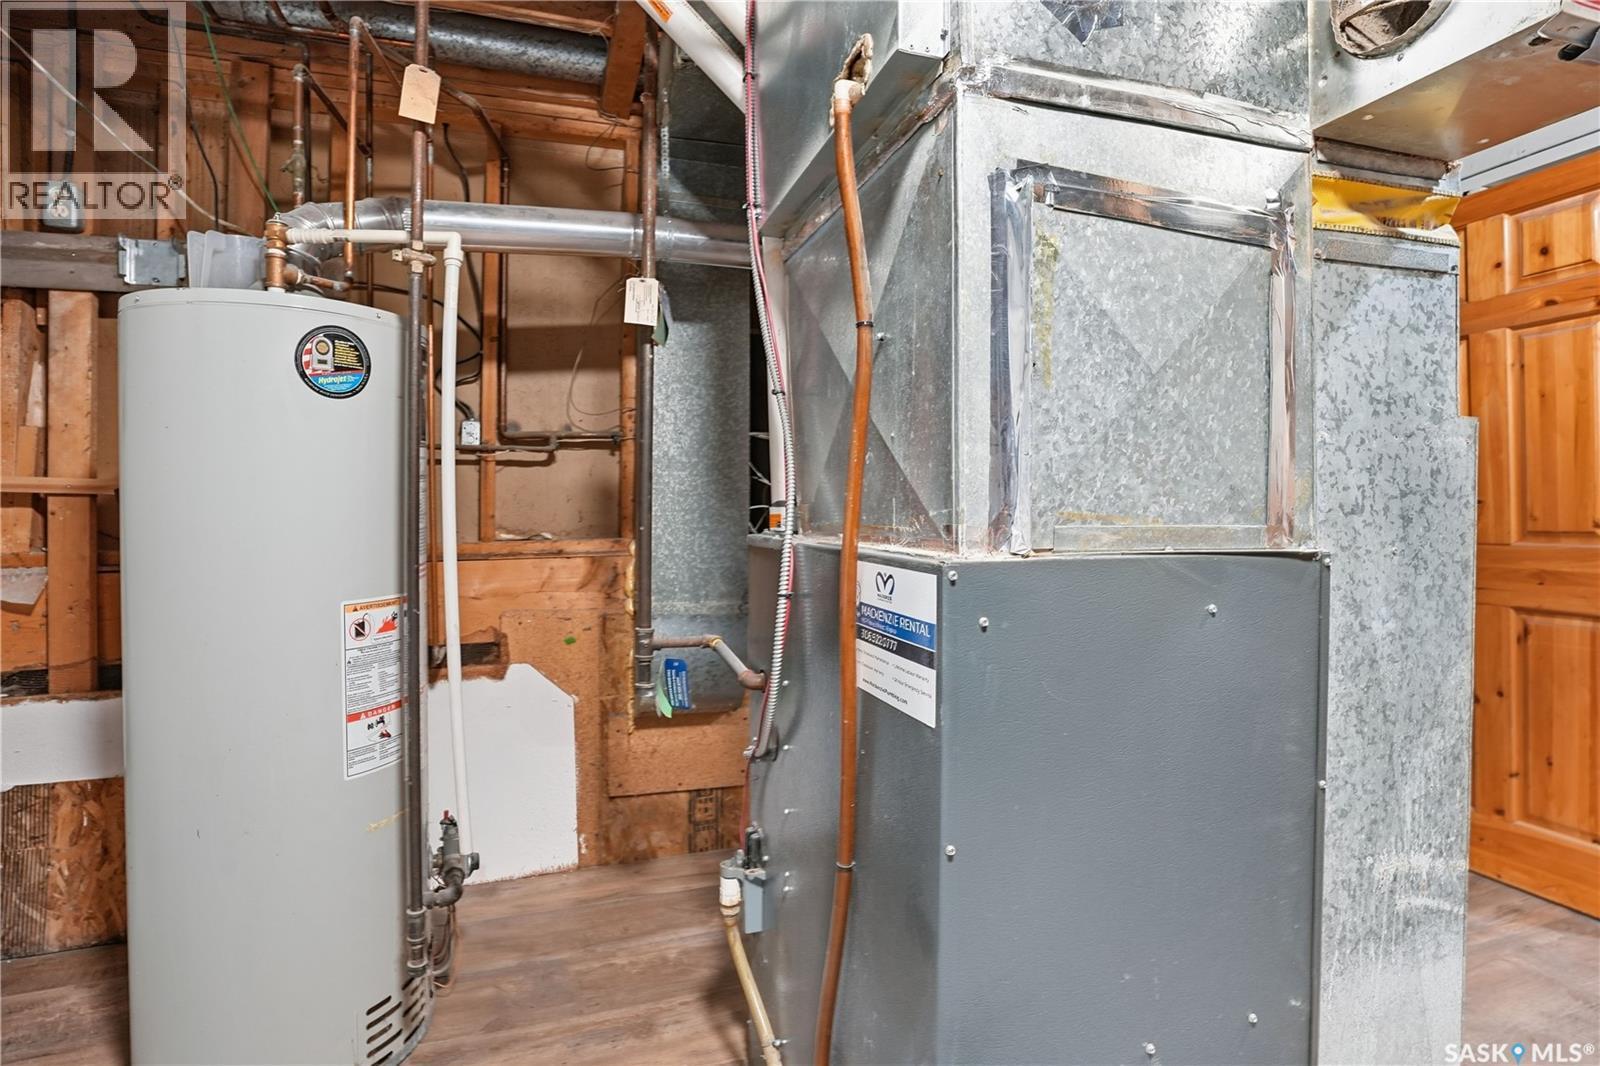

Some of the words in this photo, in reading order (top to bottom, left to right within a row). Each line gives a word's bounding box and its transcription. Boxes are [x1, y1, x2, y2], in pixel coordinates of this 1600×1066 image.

[318, 375, 348, 385] Hydrojet
[861, 605, 899, 627] MACKENZIE
[900, 617, 931, 638] RENTAL
[367, 703, 396, 717] DANGER
